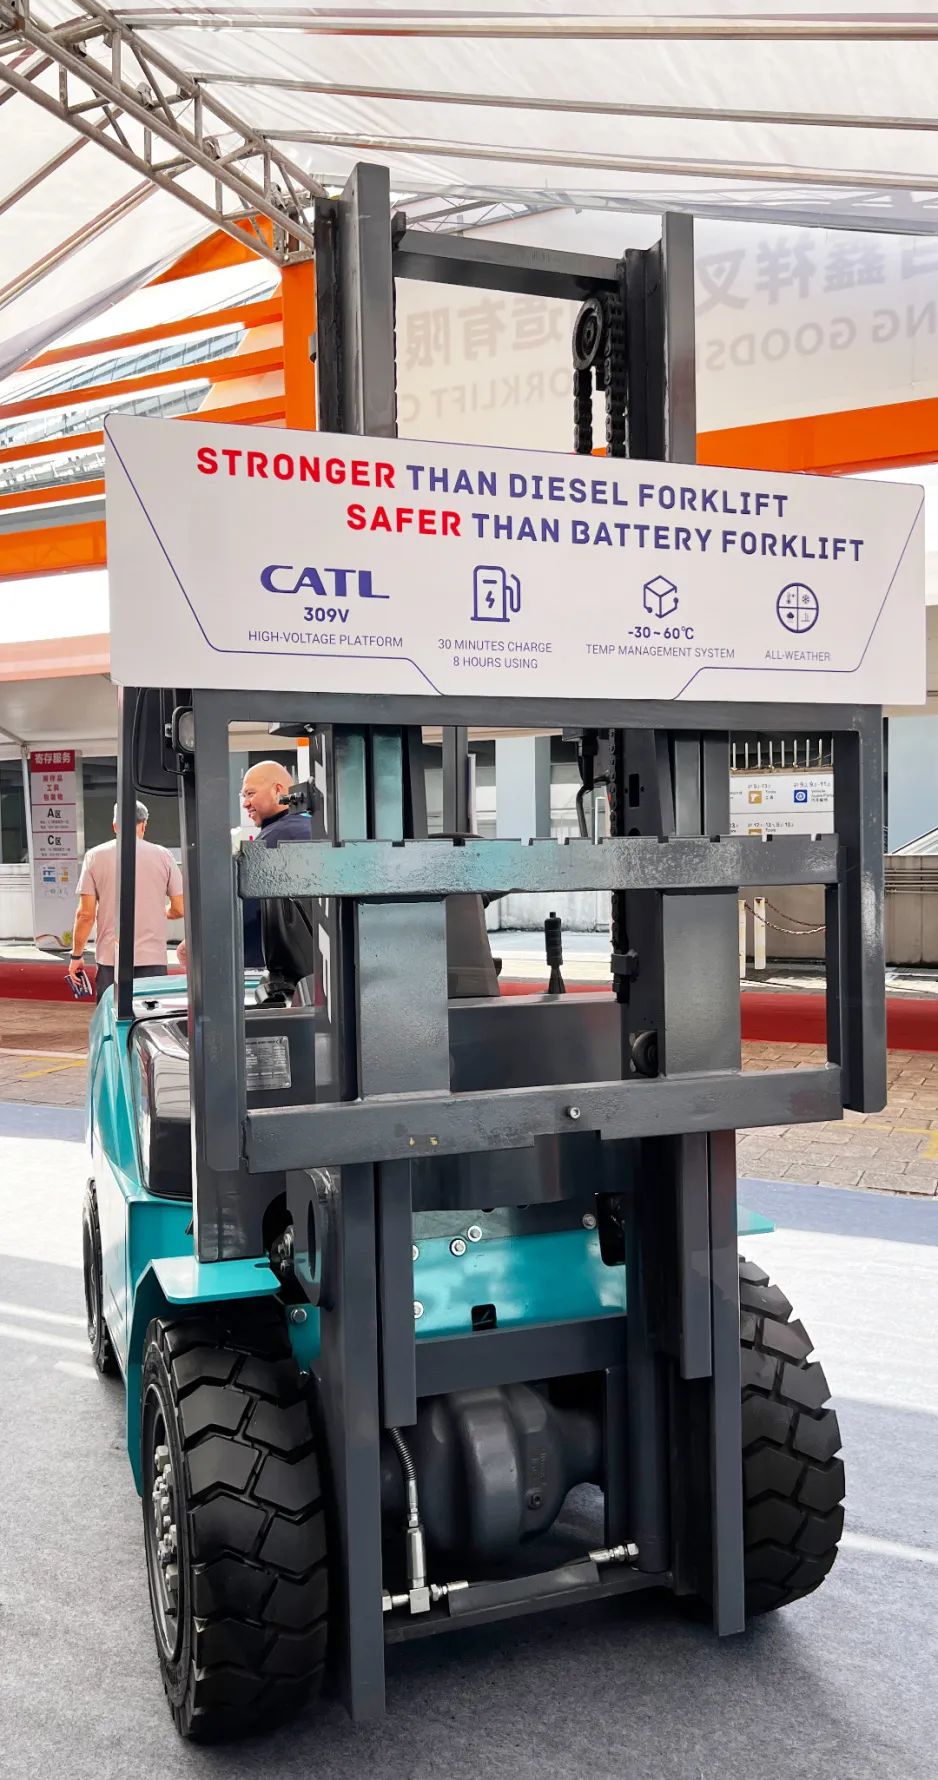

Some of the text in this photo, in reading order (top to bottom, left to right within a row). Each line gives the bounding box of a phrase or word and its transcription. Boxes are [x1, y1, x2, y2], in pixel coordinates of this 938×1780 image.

[197, 447, 788, 517] STRONGER THAN DIESEL FORKLIFT
[347, 504, 864, 562] SAFER THAN BATTERY FORKLIFT
[260, 565, 390, 599] CATL
[303, 606, 350, 623] 309V
[248, 630, 403, 648] HIGH-VOLTAGE PLATFORM
[437, 638, 553, 653] 30 MINUTES CHARGE
[586, 643, 735, 659] TEMP MANAGEMENT SYSTEM
[765, 649, 831, 662] ALL-WEATHER
[453, 656, 538, 669] 8 HOURS USING
[35, 752, 71, 765] 寄存服务
